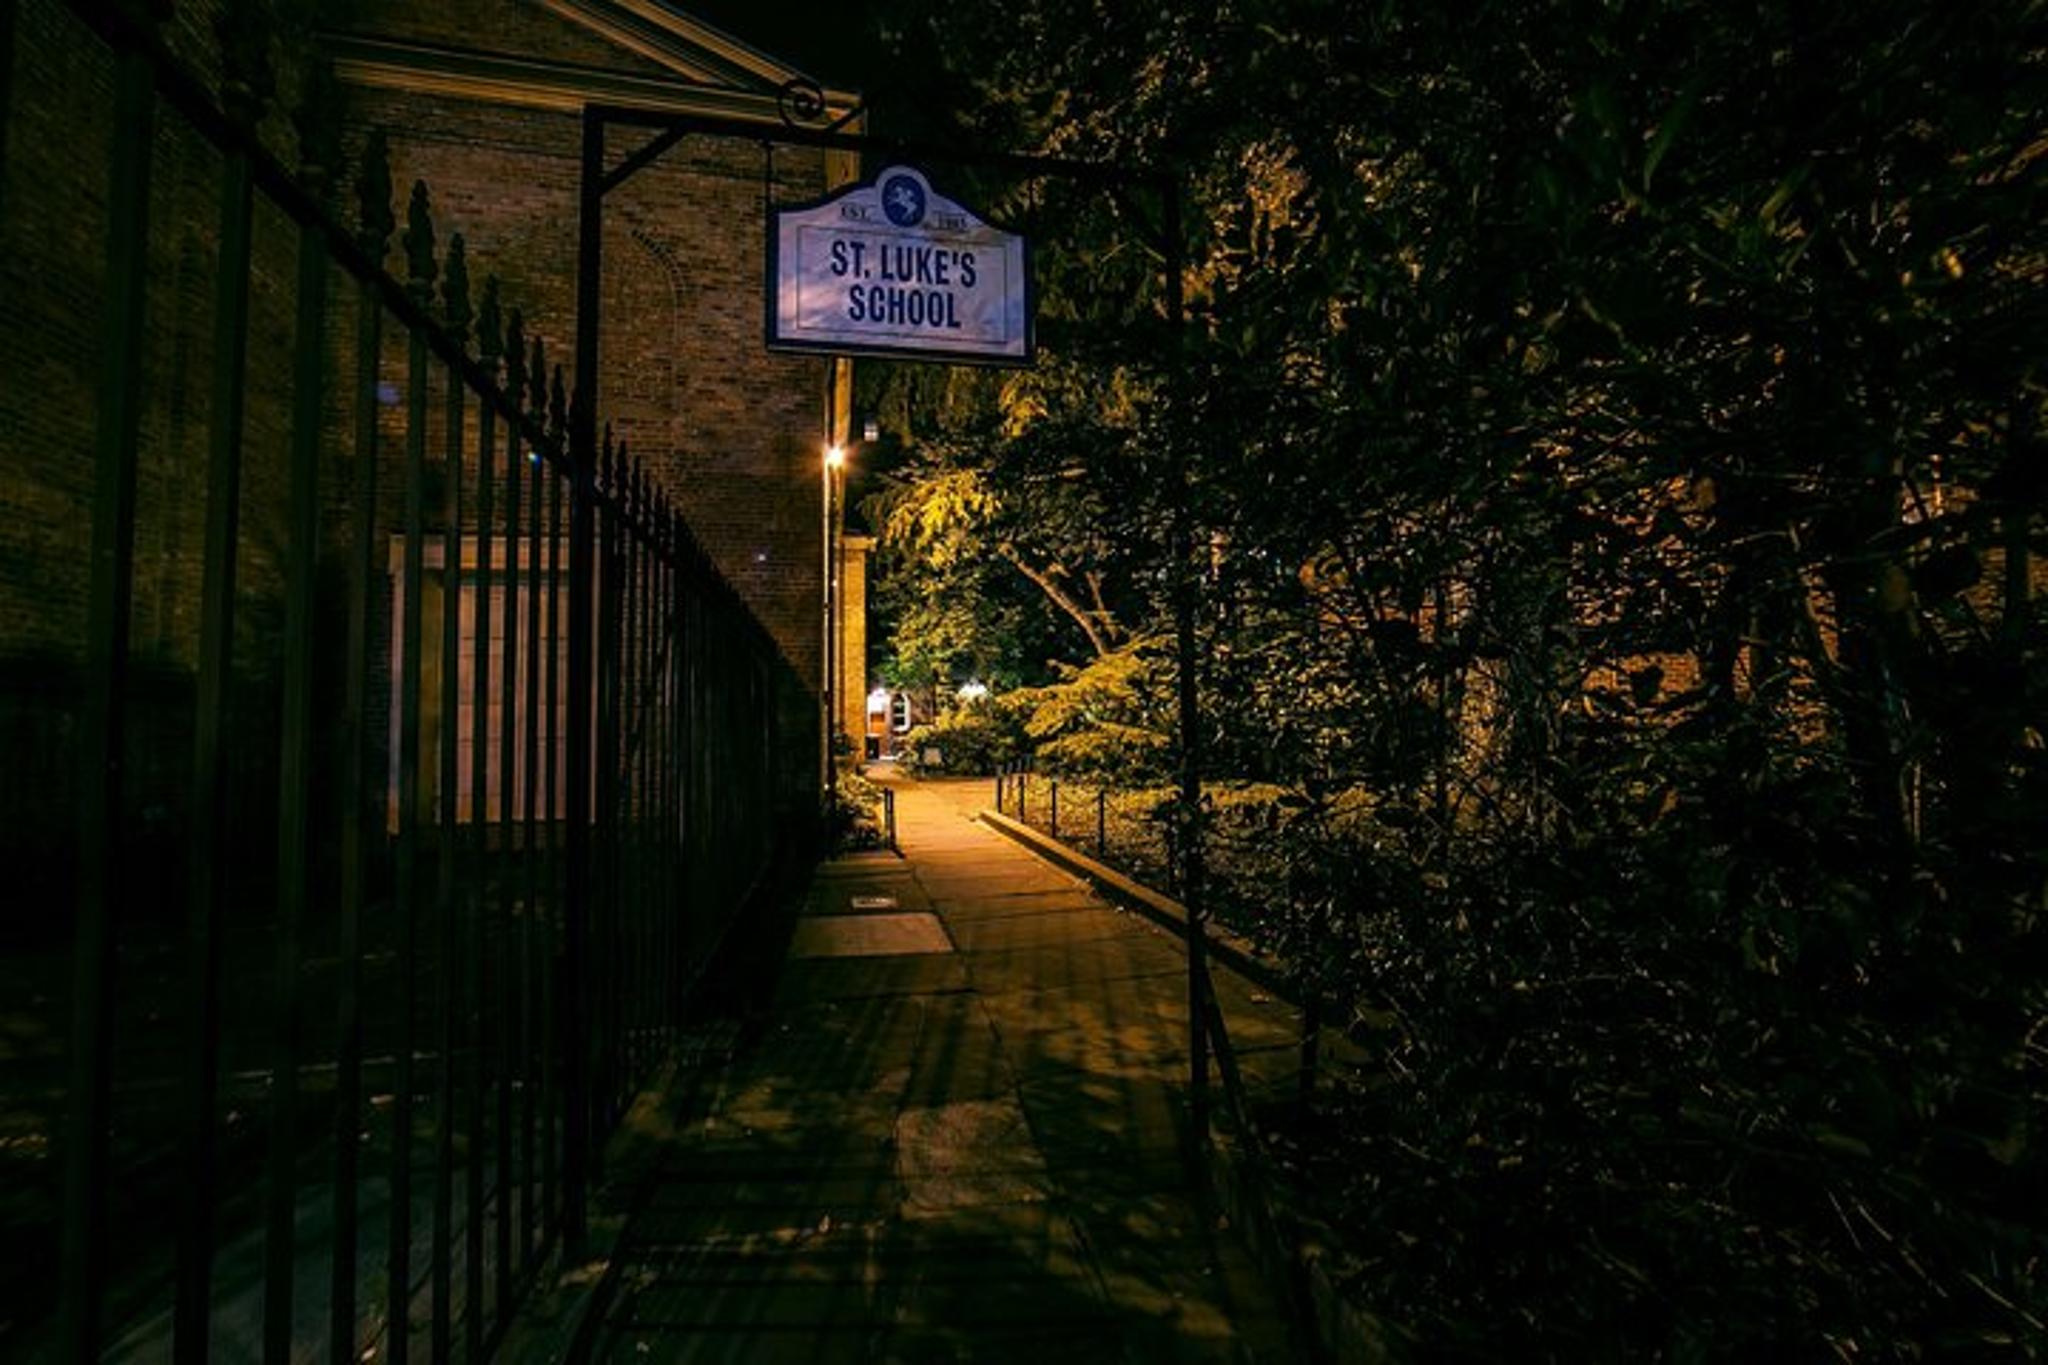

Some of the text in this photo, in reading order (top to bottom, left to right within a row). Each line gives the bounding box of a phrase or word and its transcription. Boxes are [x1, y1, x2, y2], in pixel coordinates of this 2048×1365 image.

[831, 240, 976, 287] ST. LUKE'S
[849, 284, 961, 328] SCHOOL
